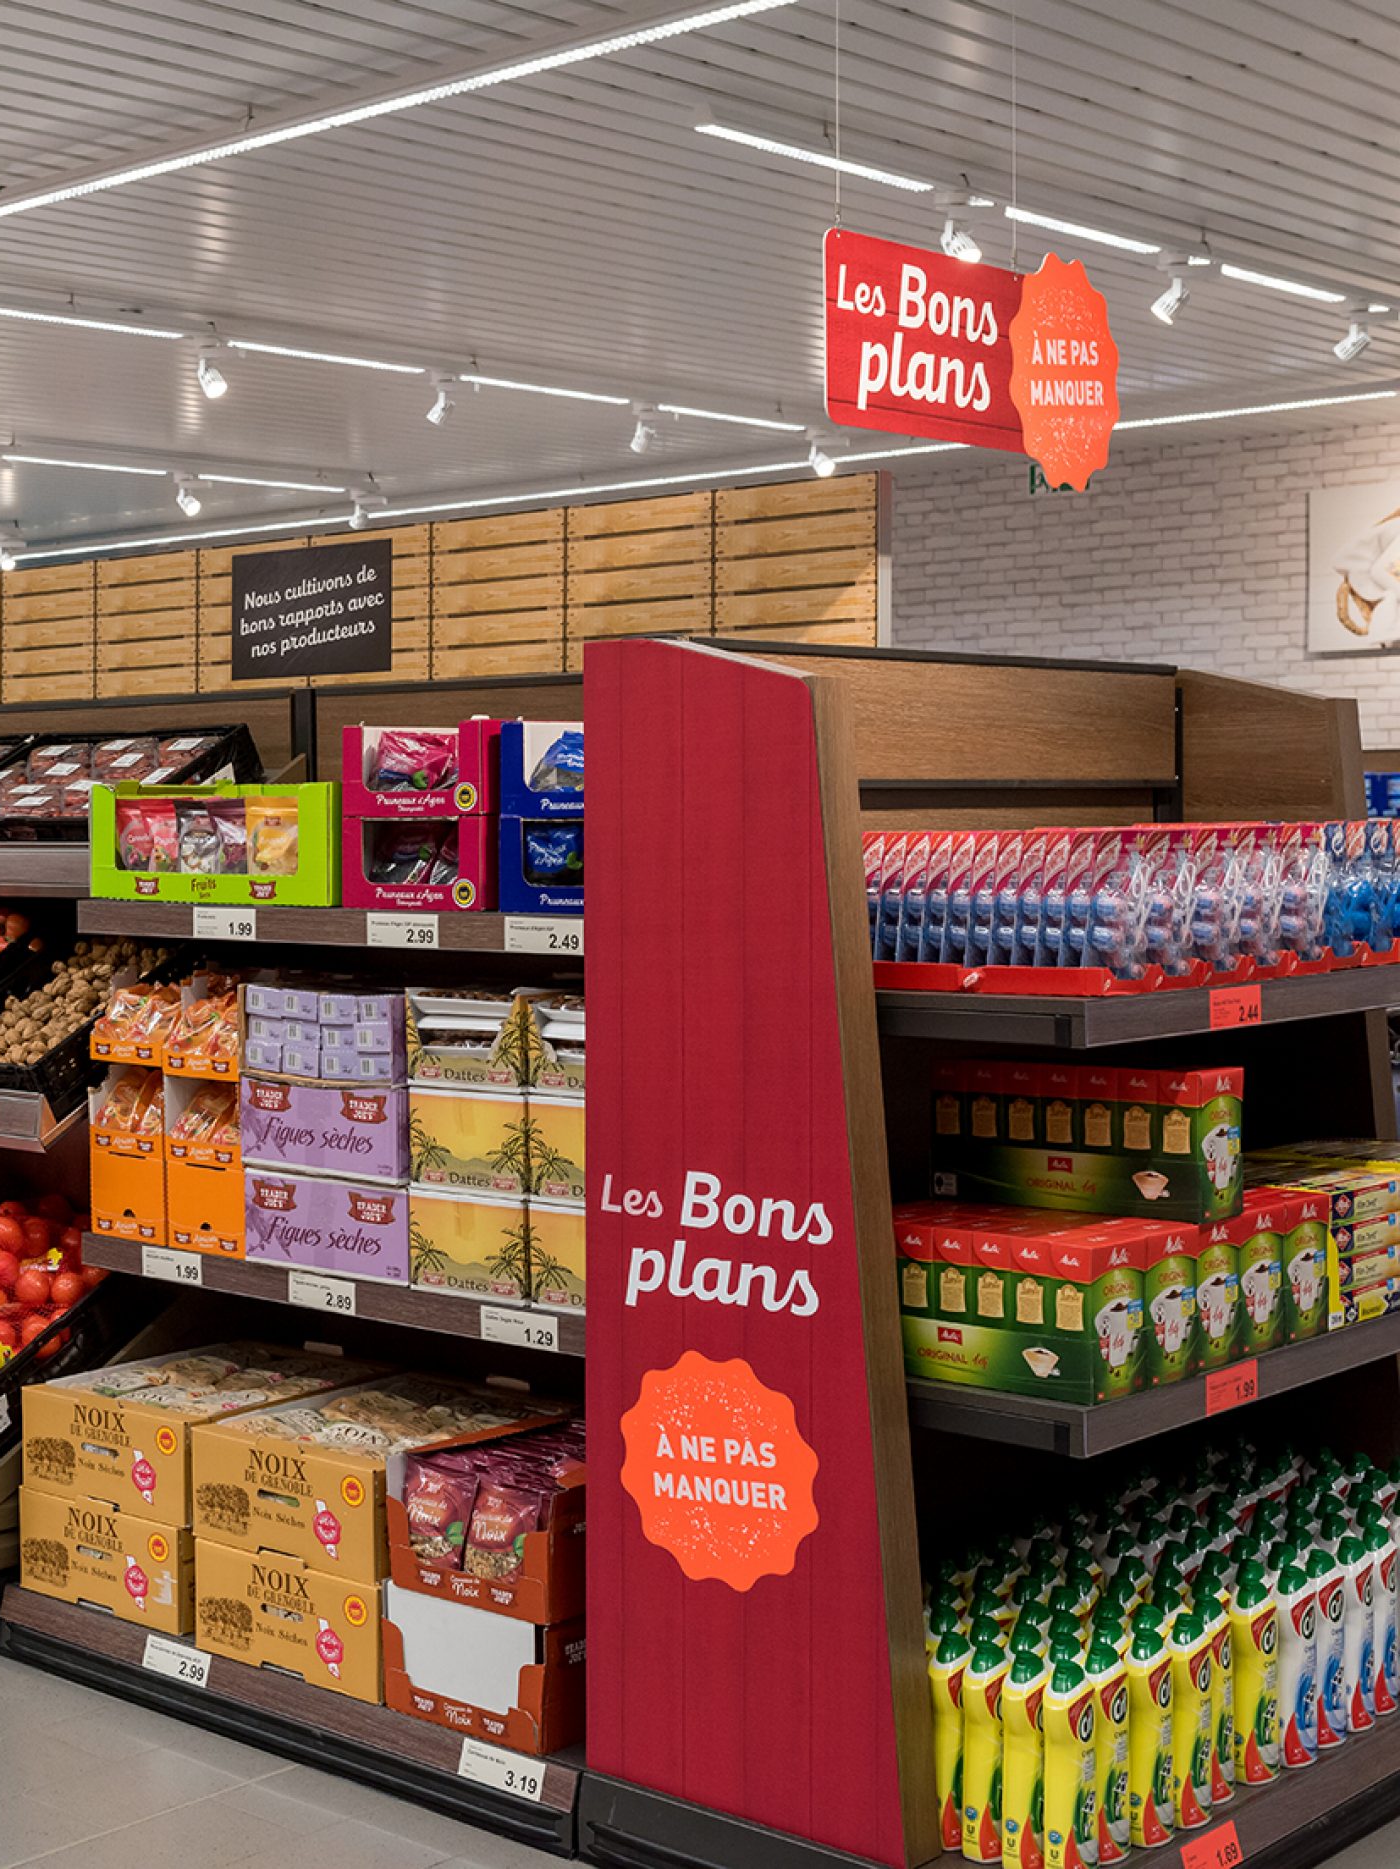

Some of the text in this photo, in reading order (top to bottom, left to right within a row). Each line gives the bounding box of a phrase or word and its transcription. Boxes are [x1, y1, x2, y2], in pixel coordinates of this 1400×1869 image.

[836, 263, 999, 347] Les Bons
[1032, 331, 1100, 367] À NE PAS
[858, 331, 991, 411] plans
[1030, 380, 1105, 408] MANQUER
[244, 564, 378, 611] Nous cultivons de
[240, 592, 385, 636] bons rapports avec
[251, 620, 376, 658] nos producteurs
[191, 878, 217, 893] Fruits
[229, 922, 253, 936] 1.99
[406, 929, 434, 944] 2.99
[549, 934, 580, 950] 2.49
[1239, 1004, 1259, 1022] 2.44
[444, 1067, 485, 1082] Dattes
[262, 1117, 373, 1154] Figues sèches
[450, 1173, 491, 1188] Dattes
[600, 1171, 834, 1244] Les Bons
[265, 1216, 382, 1255] Figues sèches
[176, 1264, 199, 1281] 1.99
[447, 1275, 489, 1292] Dattes
[625, 1240, 820, 1316] plans
[325, 1292, 351, 1310] 2.89
[524, 1328, 553, 1346] 1.29
[917, 1347, 969, 1364] ORIGINAL
[1236, 1379, 1255, 1400] 1.99
[73, 1404, 126, 1433] NOIX
[656, 1424, 777, 1469] À NE PAS
[249, 1449, 307, 1481] NOIX
[653, 1472, 788, 1511] MANQUER
[68, 1507, 118, 1538] NOIX
[473, 1521, 508, 1542] Noix
[252, 1564, 310, 1600] NOIX
[452, 1582, 480, 1598] Noix
[179, 1661, 204, 1681] 2.99
[445, 1710, 472, 1726] Noix
[504, 1770, 538, 1794] 3.19
[1216, 1842, 1238, 1867] 1.69
